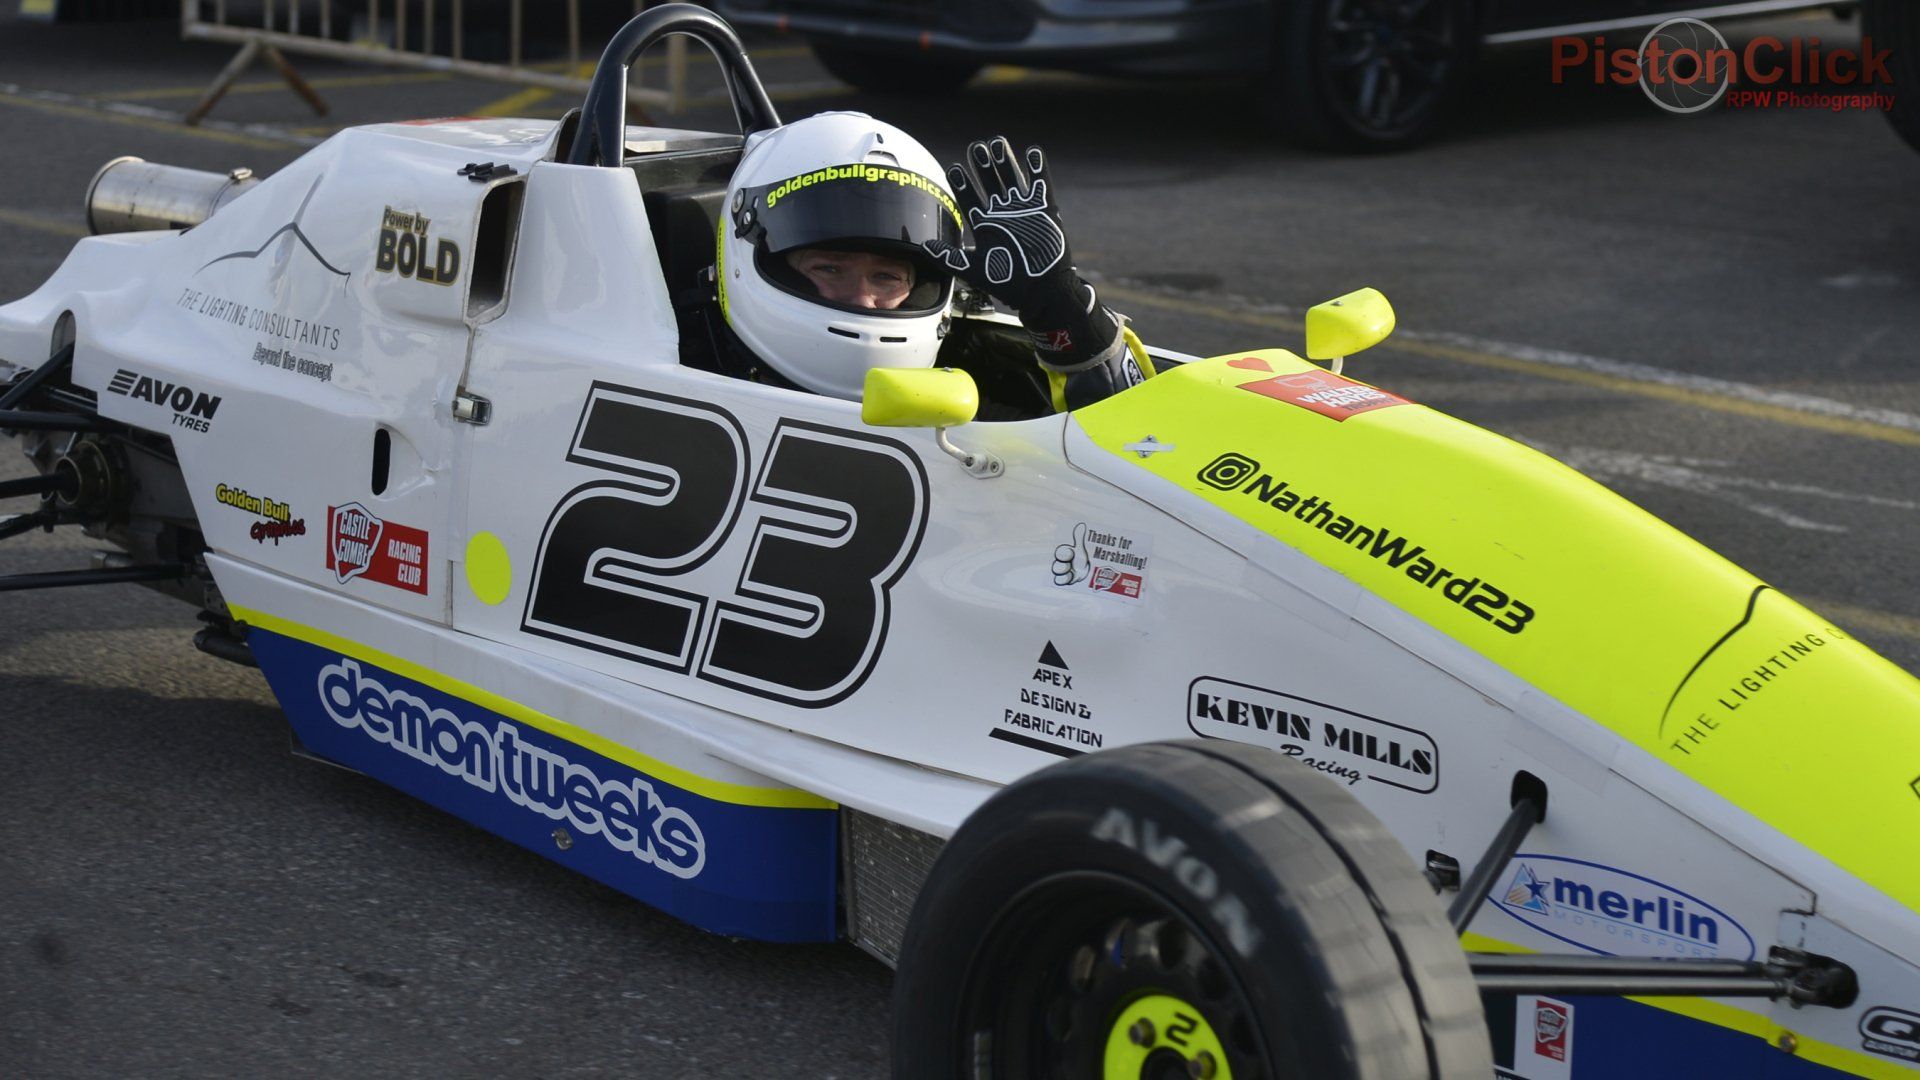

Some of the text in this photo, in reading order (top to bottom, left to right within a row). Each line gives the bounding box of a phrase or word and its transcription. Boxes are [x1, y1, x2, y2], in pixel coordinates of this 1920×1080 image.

[382, 204, 432, 236] Power by
[375, 228, 461, 287] BOLD
[176, 288, 340, 350] THE LIGHTING CONSULTANTS
[252, 342, 333, 382] Beyond the concept
[130, 376, 222, 420] AVON
[172, 413, 210, 433] TYRES
[216, 483, 291, 523] Golden Bull
[340, 511, 371, 540] CASTLE
[519, 379, 931, 709] 23
[1087, 529, 1133, 550] Thanks for
[338, 538, 370, 567] COMBE
[388, 539, 422, 564] RACING
[1093, 546, 1147, 570] Marshalling!
[398, 563, 421, 586] CLUB
[1032, 668, 1072, 690] APEX
[1671, 633, 1826, 755] THE LIGHTING
[1004, 708, 1102, 748] FABRICATION
[1196, 692, 1432, 775] KEVIN MILLS
[1553, 877, 1718, 945] merlin
[1554, 910, 1718, 958] MOTORSPORT
